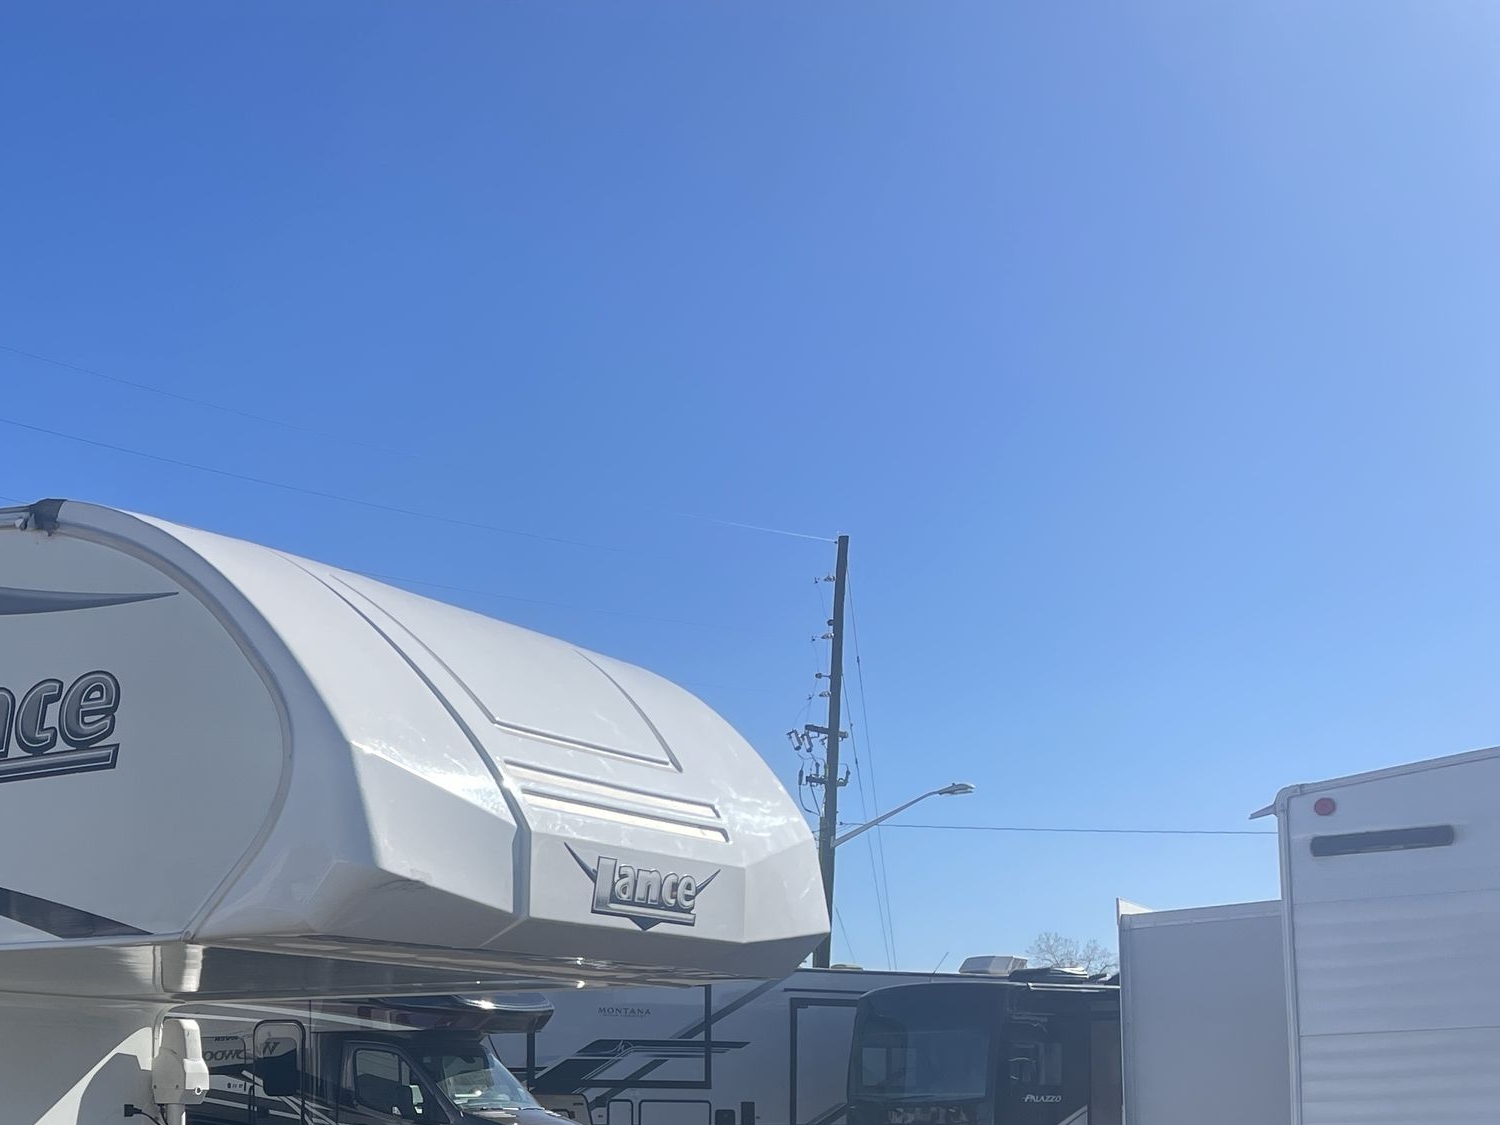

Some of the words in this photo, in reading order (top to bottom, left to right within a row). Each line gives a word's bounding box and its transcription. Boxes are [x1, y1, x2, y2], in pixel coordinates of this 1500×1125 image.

[591, 856, 697, 926] Lance
[597, 1007, 652, 1016] MONTANA
[1022, 1094, 1062, 1103] PALAZZO
